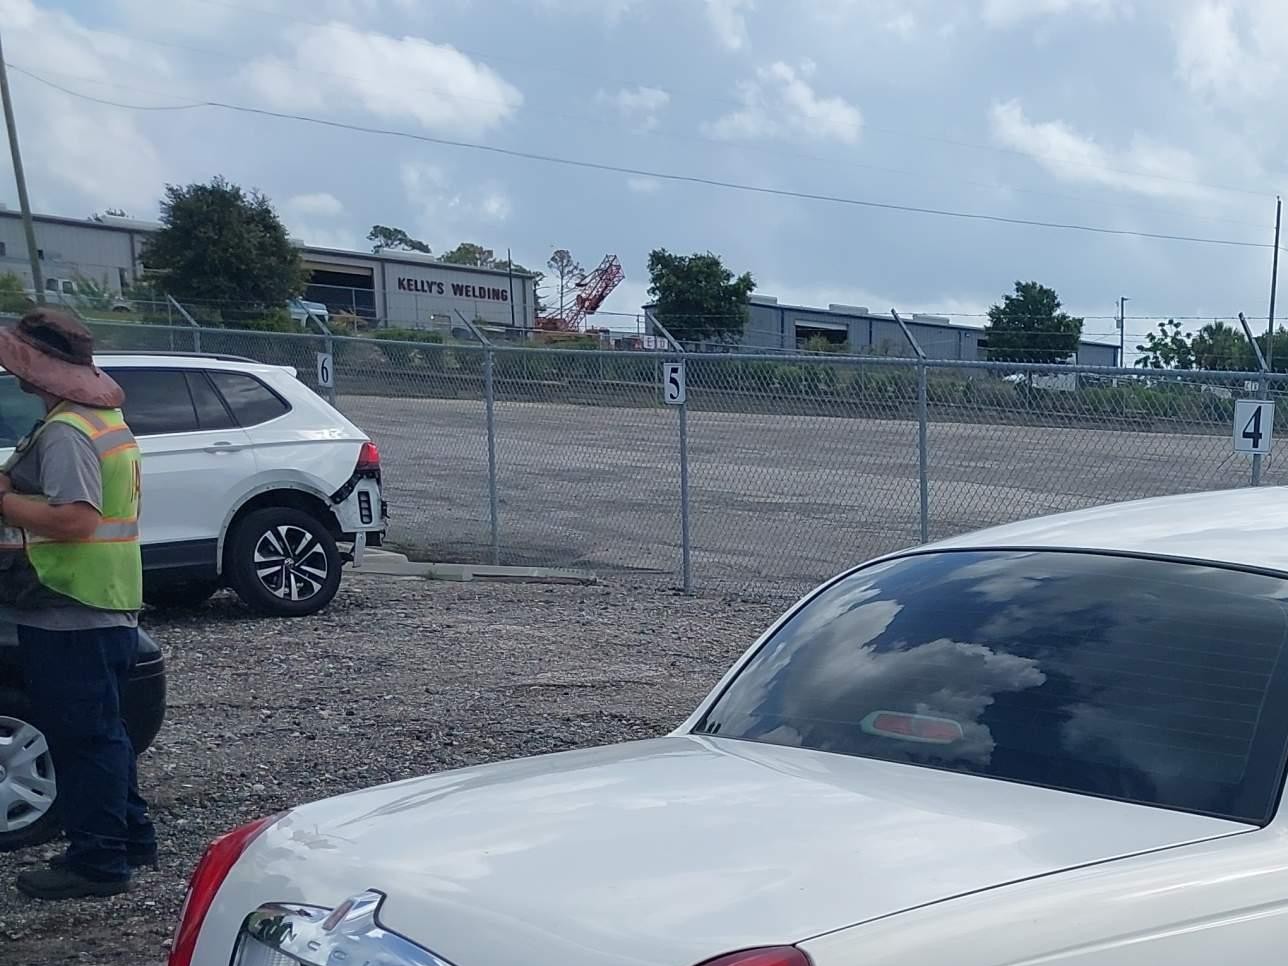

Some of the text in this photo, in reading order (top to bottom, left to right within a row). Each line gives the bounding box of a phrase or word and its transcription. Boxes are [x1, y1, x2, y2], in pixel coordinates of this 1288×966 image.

[397, 277, 509, 301] KELLY'S WELDING
[321, 357, 329, 384] 6
[669, 367, 680, 400] 5
[1242, 405, 1263, 449] 4
